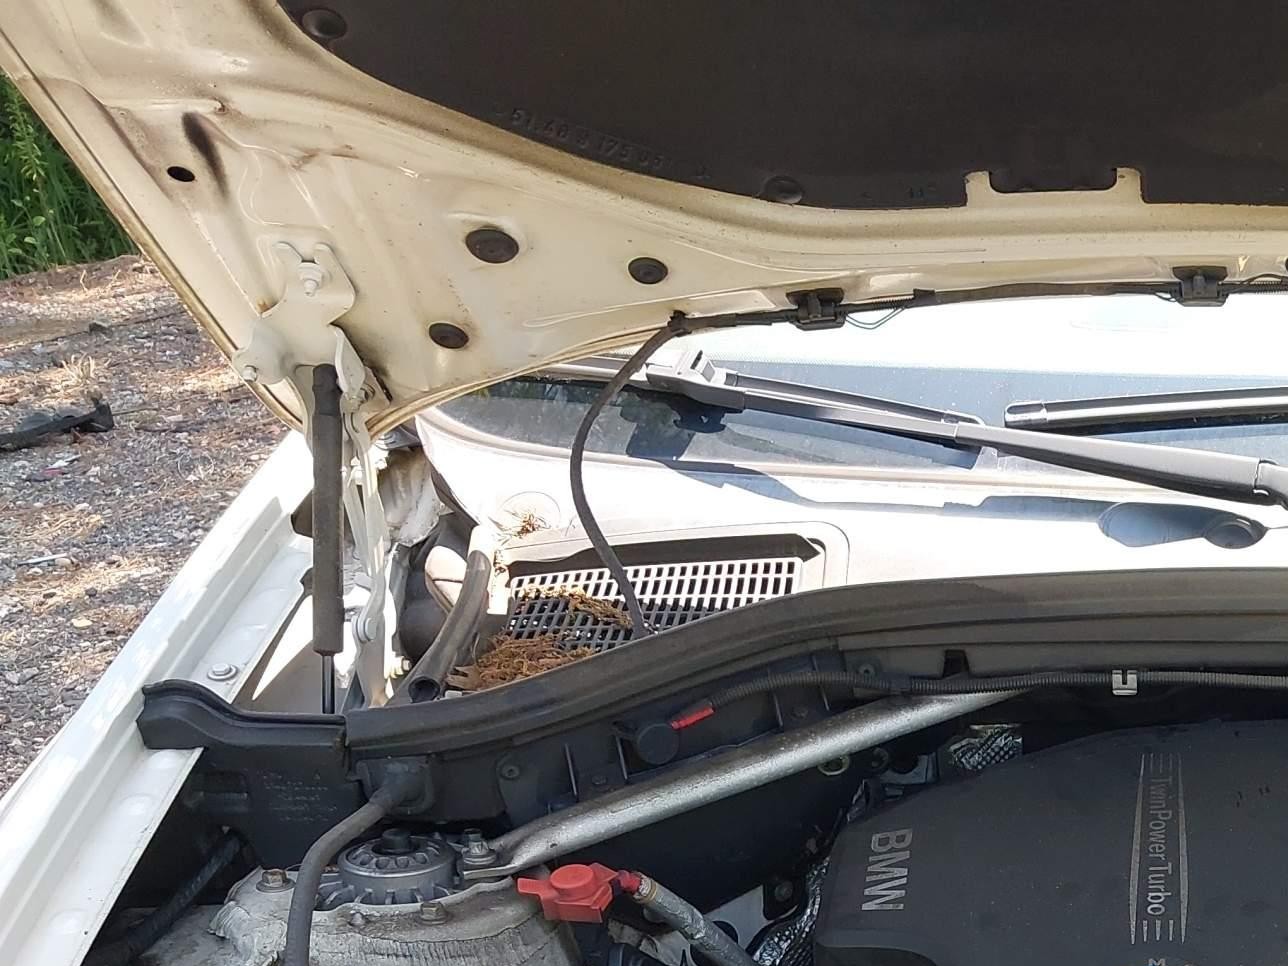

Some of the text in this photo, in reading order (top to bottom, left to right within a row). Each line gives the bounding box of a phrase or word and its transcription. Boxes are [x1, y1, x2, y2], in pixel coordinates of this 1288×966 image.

[861, 828, 913, 911] BMW
[1146, 775, 1173, 916] TwinPower Turbo
